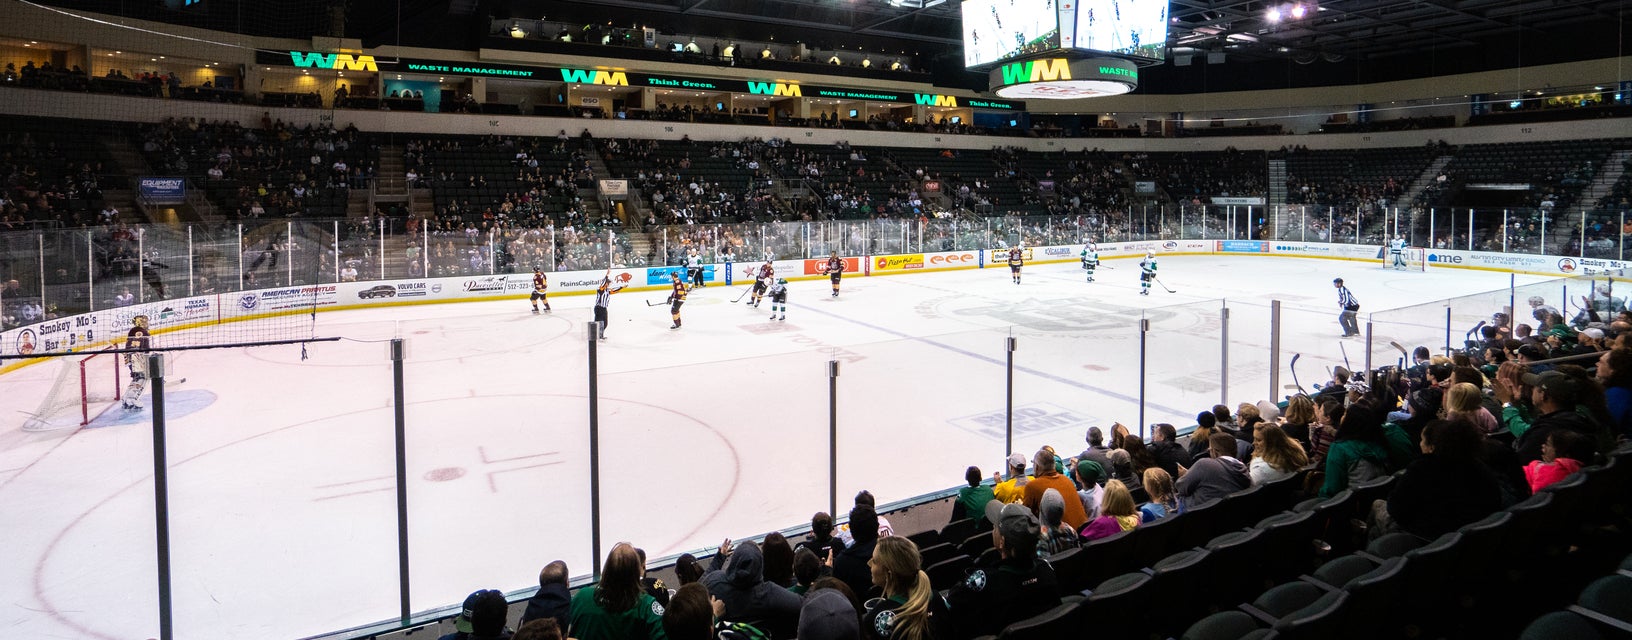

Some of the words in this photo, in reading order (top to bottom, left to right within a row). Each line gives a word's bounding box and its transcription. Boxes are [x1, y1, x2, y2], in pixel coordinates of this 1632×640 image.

[290, 51, 378, 72] WM
[408, 64, 450, 73] WASTE
[453, 67, 533, 77] MANAGEMENT
[1002, 58, 1072, 85] WM
[1099, 66, 1129, 77] WASTE
[561, 68, 629, 86] WM
[648, 78, 679, 88] Think
[682, 79, 716, 89] Green.
[747, 81, 802, 97] WM
[820, 90, 845, 98] WASTE
[847, 92, 897, 100] MANAGEMENT
[914, 93, 958, 107] WM
[969, 100, 991, 108] Think
[993, 101, 1012, 109] Green.
[560, 279, 600, 288] PlainsCapital
[262, 289, 301, 297] AMERICAN
[39, 319, 71, 336] Smokey
[76, 314, 97, 328] Mo's
[45, 339, 60, 350] Bar
